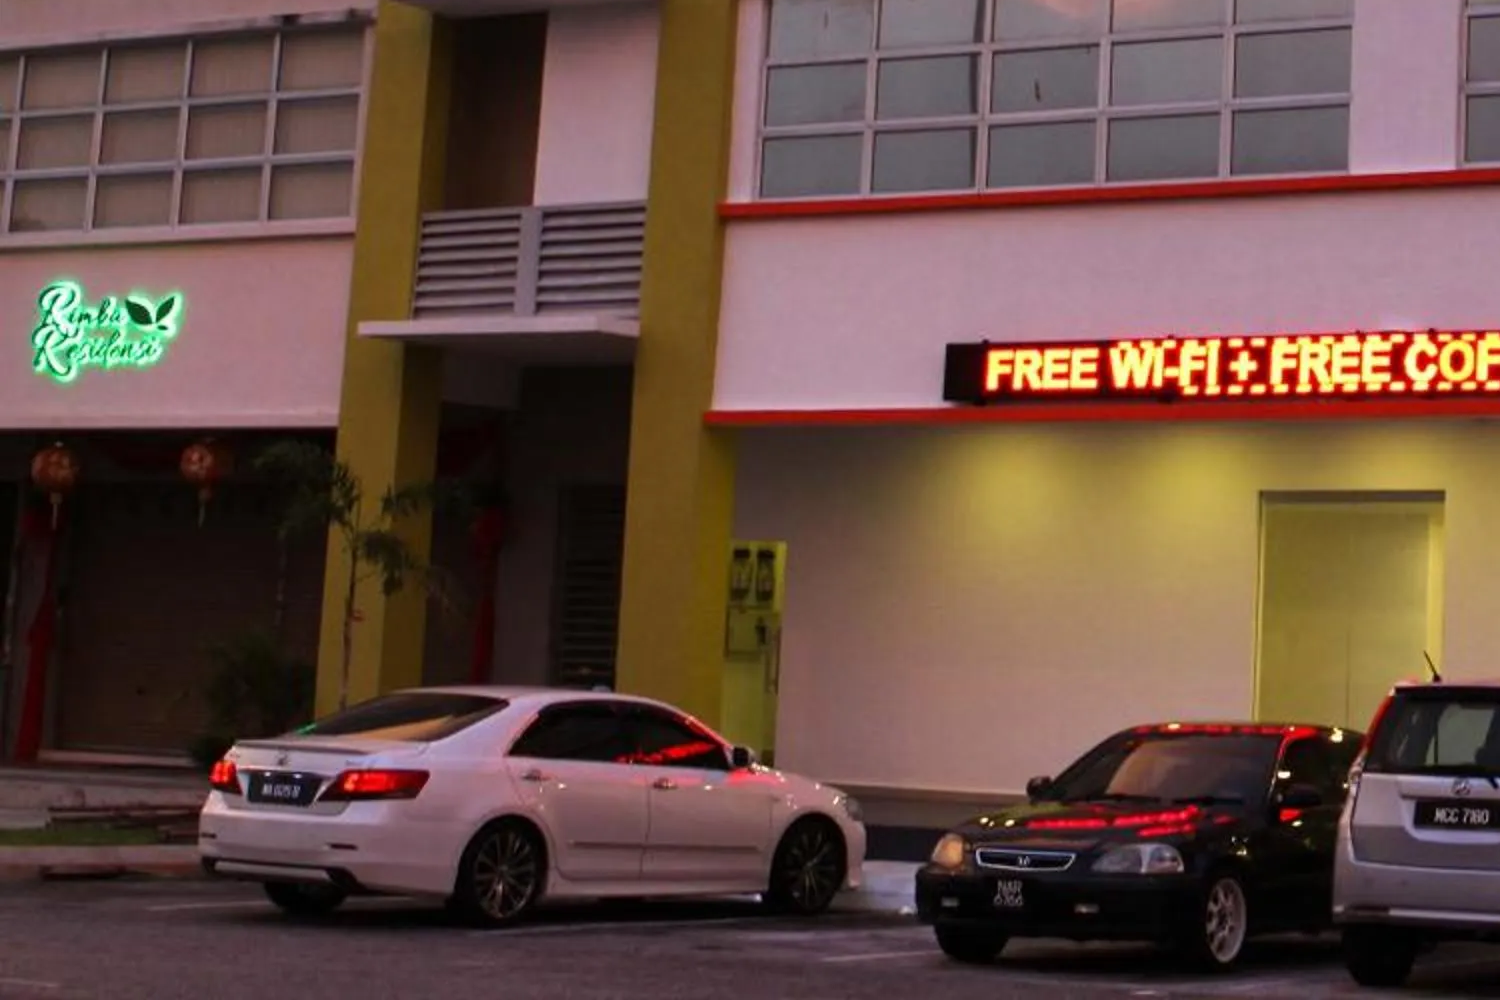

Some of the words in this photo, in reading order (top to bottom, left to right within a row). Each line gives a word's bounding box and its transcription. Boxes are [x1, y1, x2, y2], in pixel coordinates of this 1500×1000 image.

[38, 284, 124, 337] Rimba
[985, 347, 1100, 391] FREE
[1108, 341, 1221, 388] WI-FI
[1269, 340, 1391, 384] FREE
